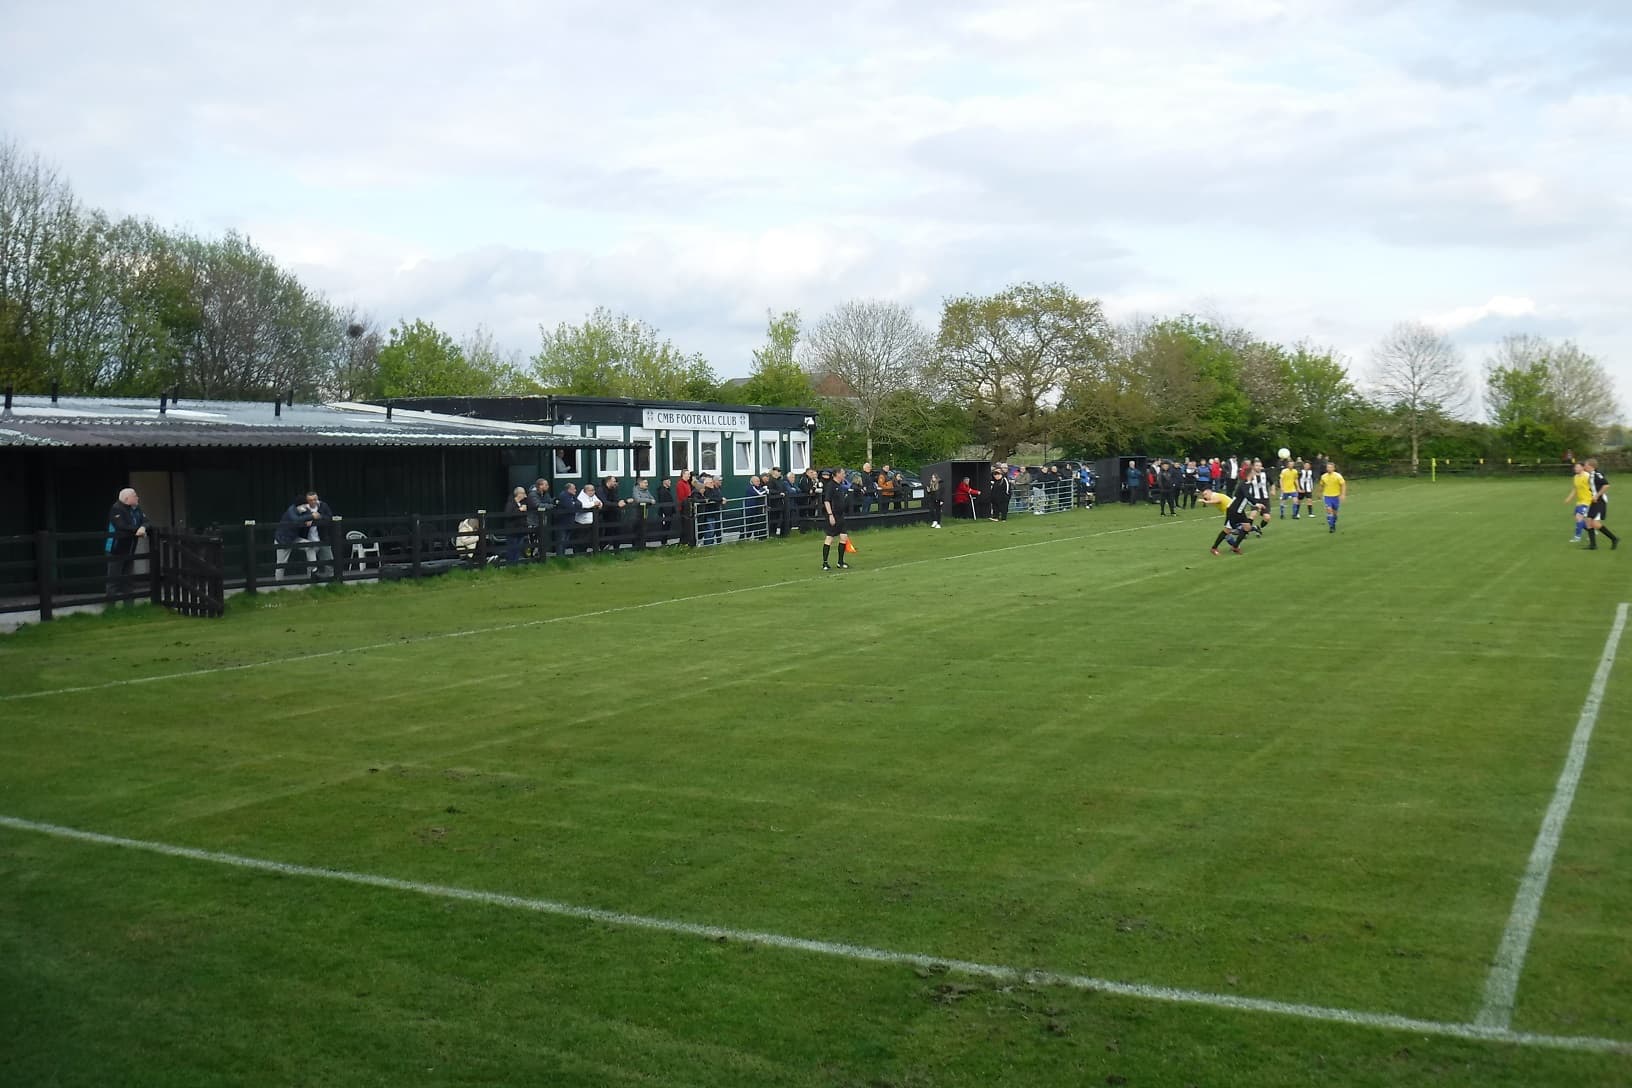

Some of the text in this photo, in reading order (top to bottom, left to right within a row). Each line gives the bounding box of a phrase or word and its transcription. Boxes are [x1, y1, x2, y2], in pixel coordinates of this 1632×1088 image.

[657, 412, 737, 426] CMB FOOTBALL CLUB
